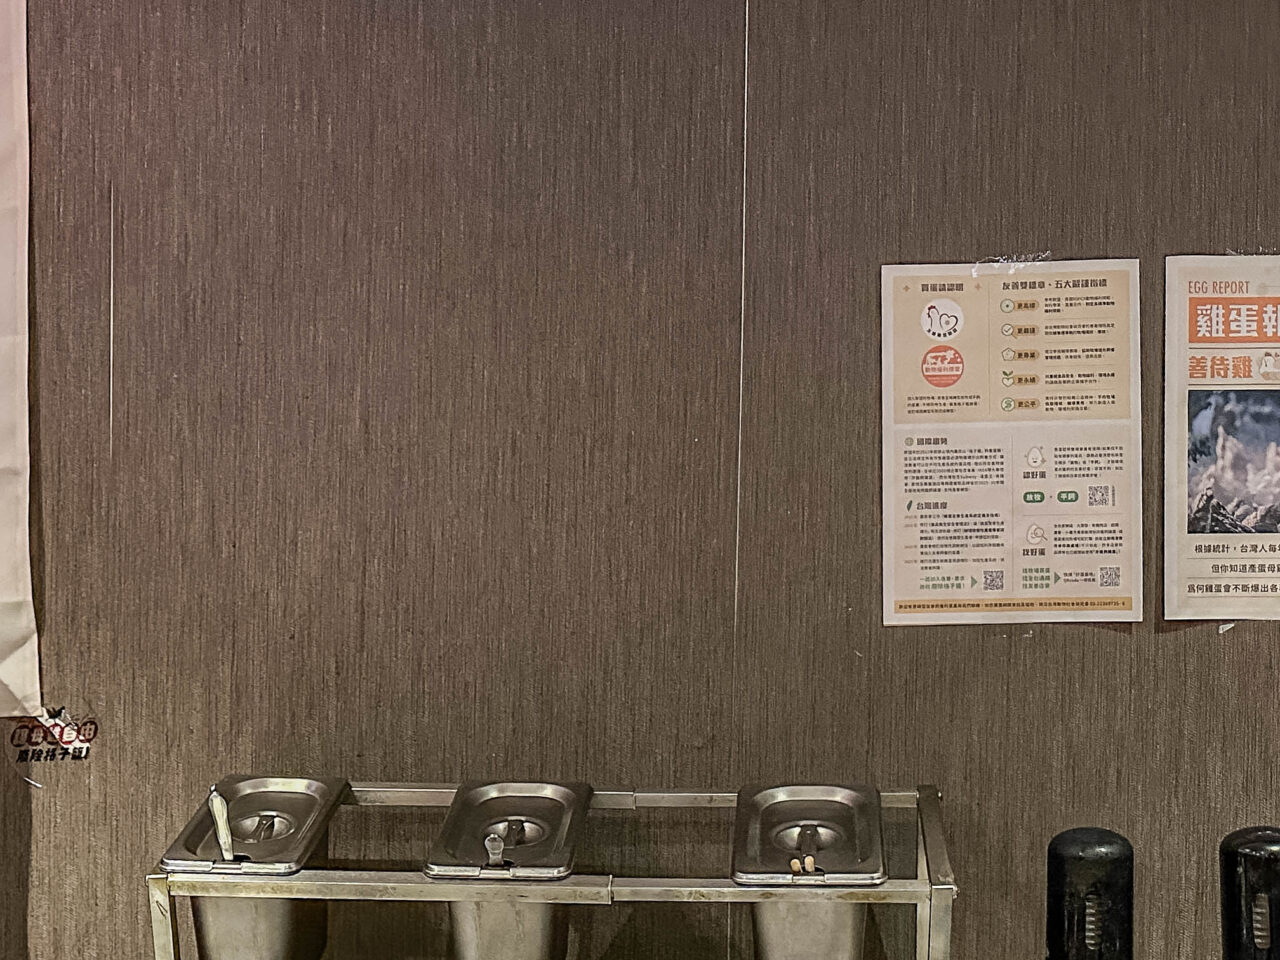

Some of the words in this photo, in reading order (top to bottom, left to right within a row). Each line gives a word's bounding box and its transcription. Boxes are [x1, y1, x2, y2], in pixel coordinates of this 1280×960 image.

[1188, 281, 1208, 294] EGG
[1212, 281, 1250, 294] REPORT
[1188, 356, 1253, 379] 善待雞
[1194, 543, 1280, 554] 根據統計，台灣人每
